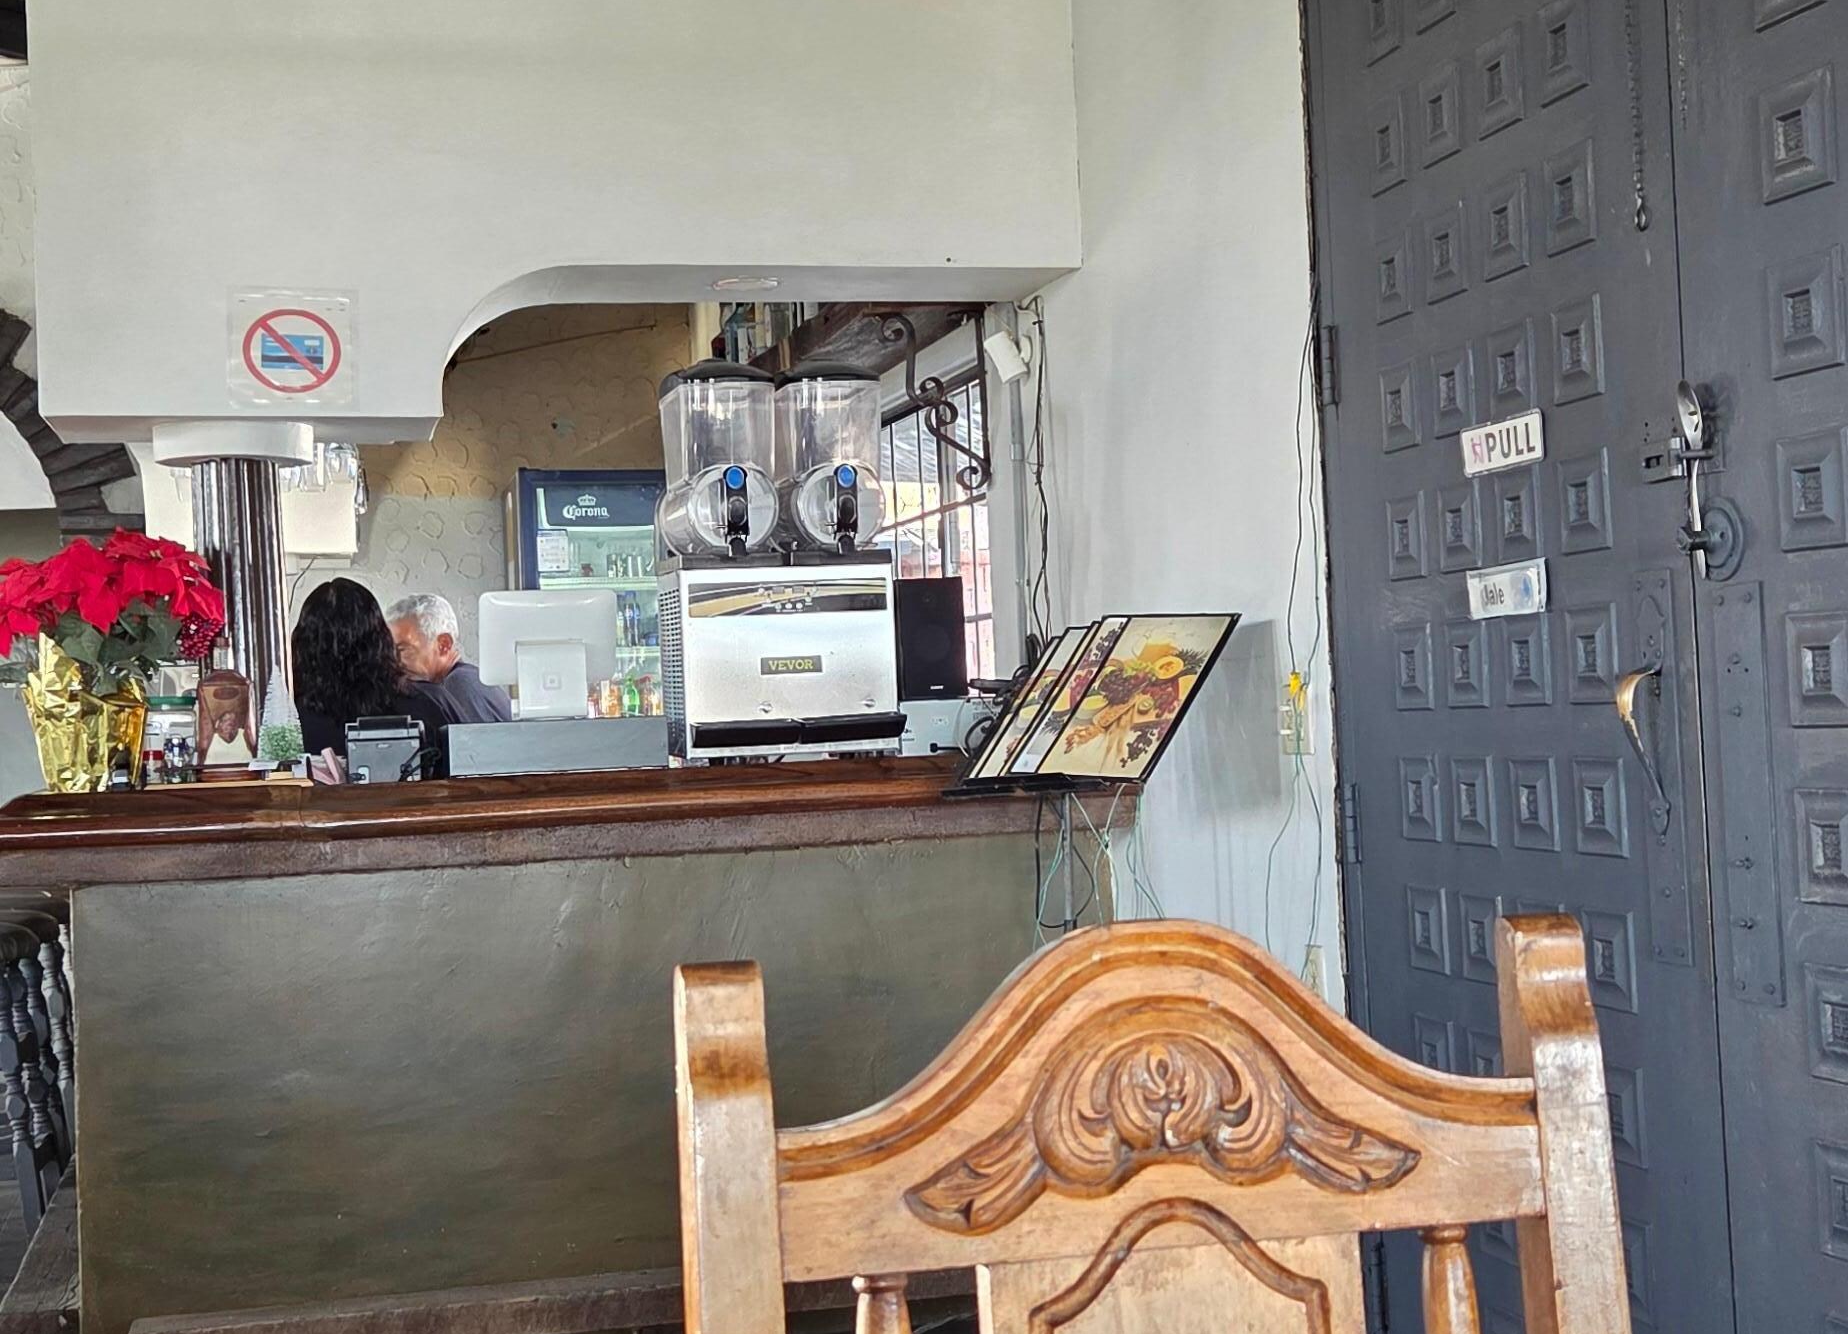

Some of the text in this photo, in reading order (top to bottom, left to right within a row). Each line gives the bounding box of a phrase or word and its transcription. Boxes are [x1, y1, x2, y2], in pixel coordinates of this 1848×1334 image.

[1485, 422, 1535, 462] PULL
[562, 504, 610, 520] Corona
[768, 658, 814, 671] VEVOR
